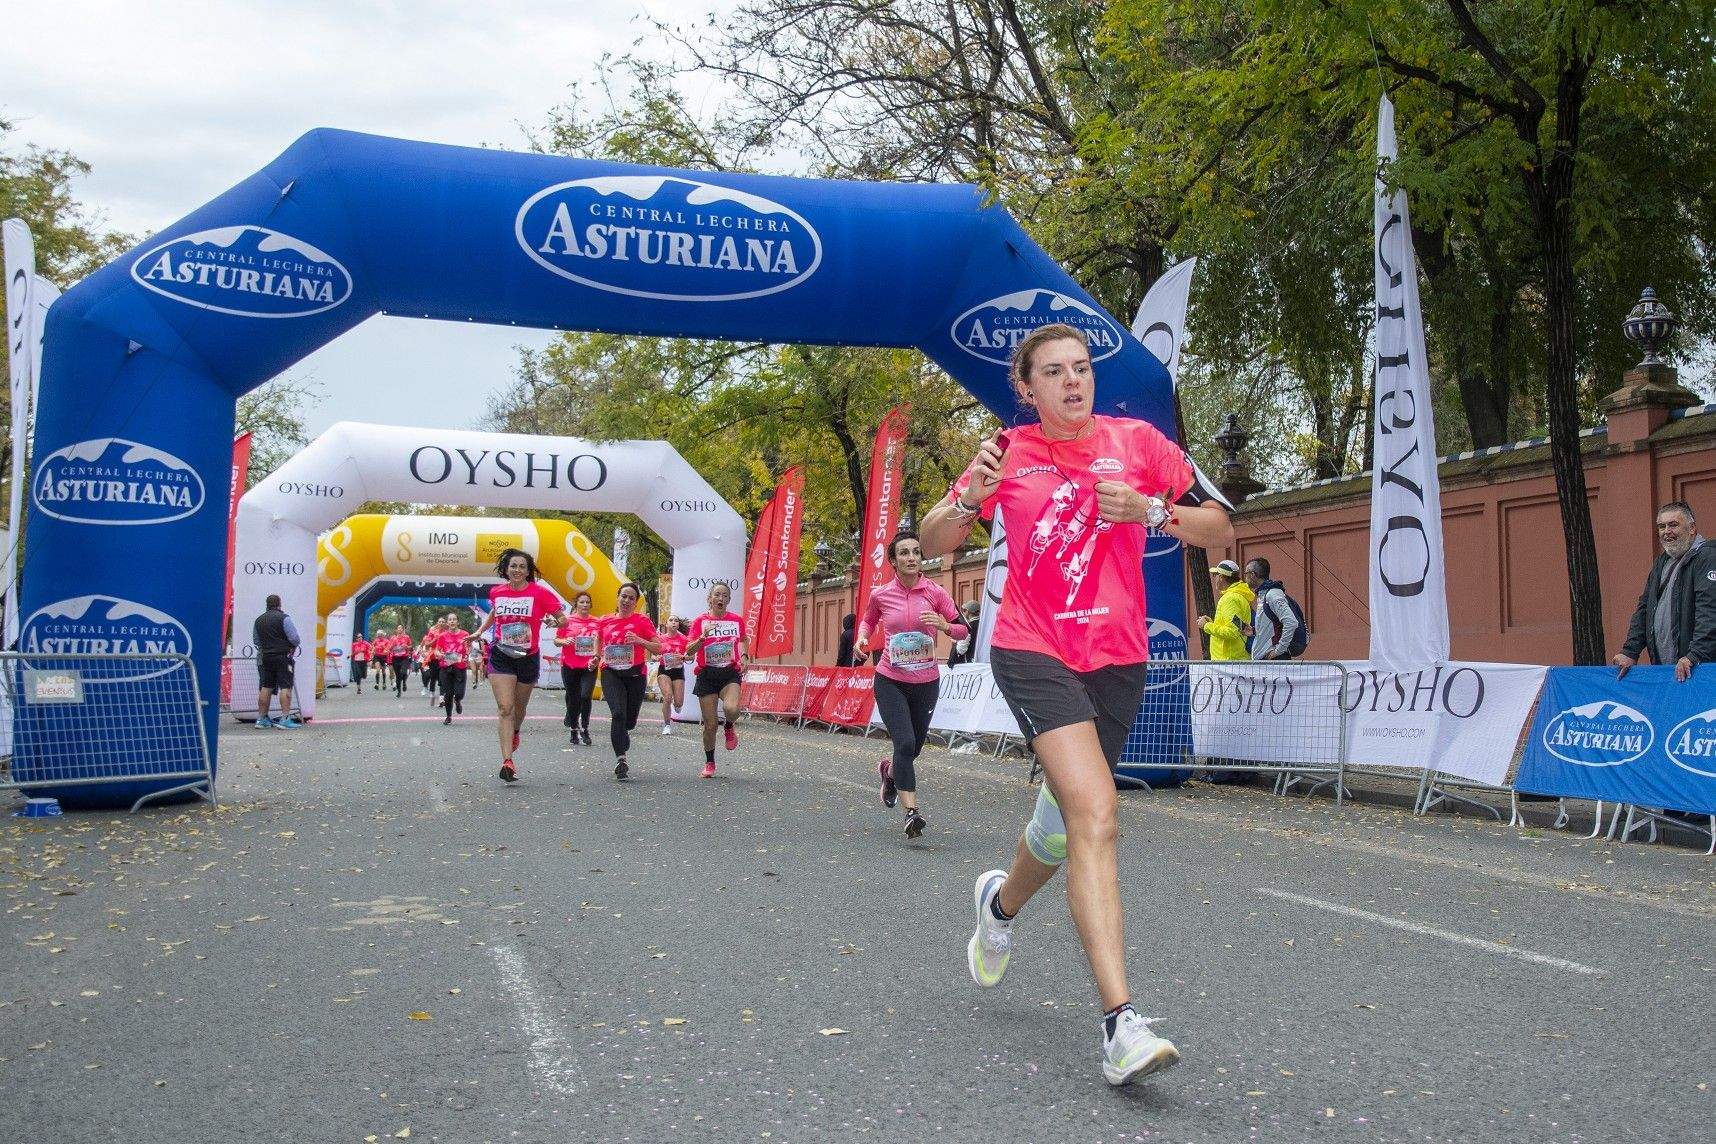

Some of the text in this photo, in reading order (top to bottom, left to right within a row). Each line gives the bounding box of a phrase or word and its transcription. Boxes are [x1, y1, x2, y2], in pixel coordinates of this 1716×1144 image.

[590, 204, 790, 232] CENTRAL LECHERA
[539, 202, 799, 274] ASTURIANA
[185, 250, 334, 277] CENTRAL LECHERA
[145, 251, 335, 303] ASTURIANA
[994, 316, 1052, 325] CENTRAL
[61, 467, 190, 483] CENTRAL LECHERA
[409, 446, 608, 491] OYSHO
[1017, 465, 1057, 477] OYSHO
[39, 469, 193, 508] ASTURIANA
[279, 481, 344, 499] OYSHO
[661, 500, 717, 513] OYSHO
[428, 533, 459, 545] IMD
[244, 562, 305, 575] OYSHO
[769, 488, 796, 643] Sports Santander
[496, 606, 529, 615] Chari
[45, 625, 175, 636] CENTRAL LECHERA
[708, 627, 738, 637] Chari
[1192, 676, 1293, 714] OYSHO
[1338, 666, 1485, 718] OYSHO
[1570, 721, 1645, 732] CENTRAL LECHERA
[1549, 721, 1642, 752] ASTURIANA
